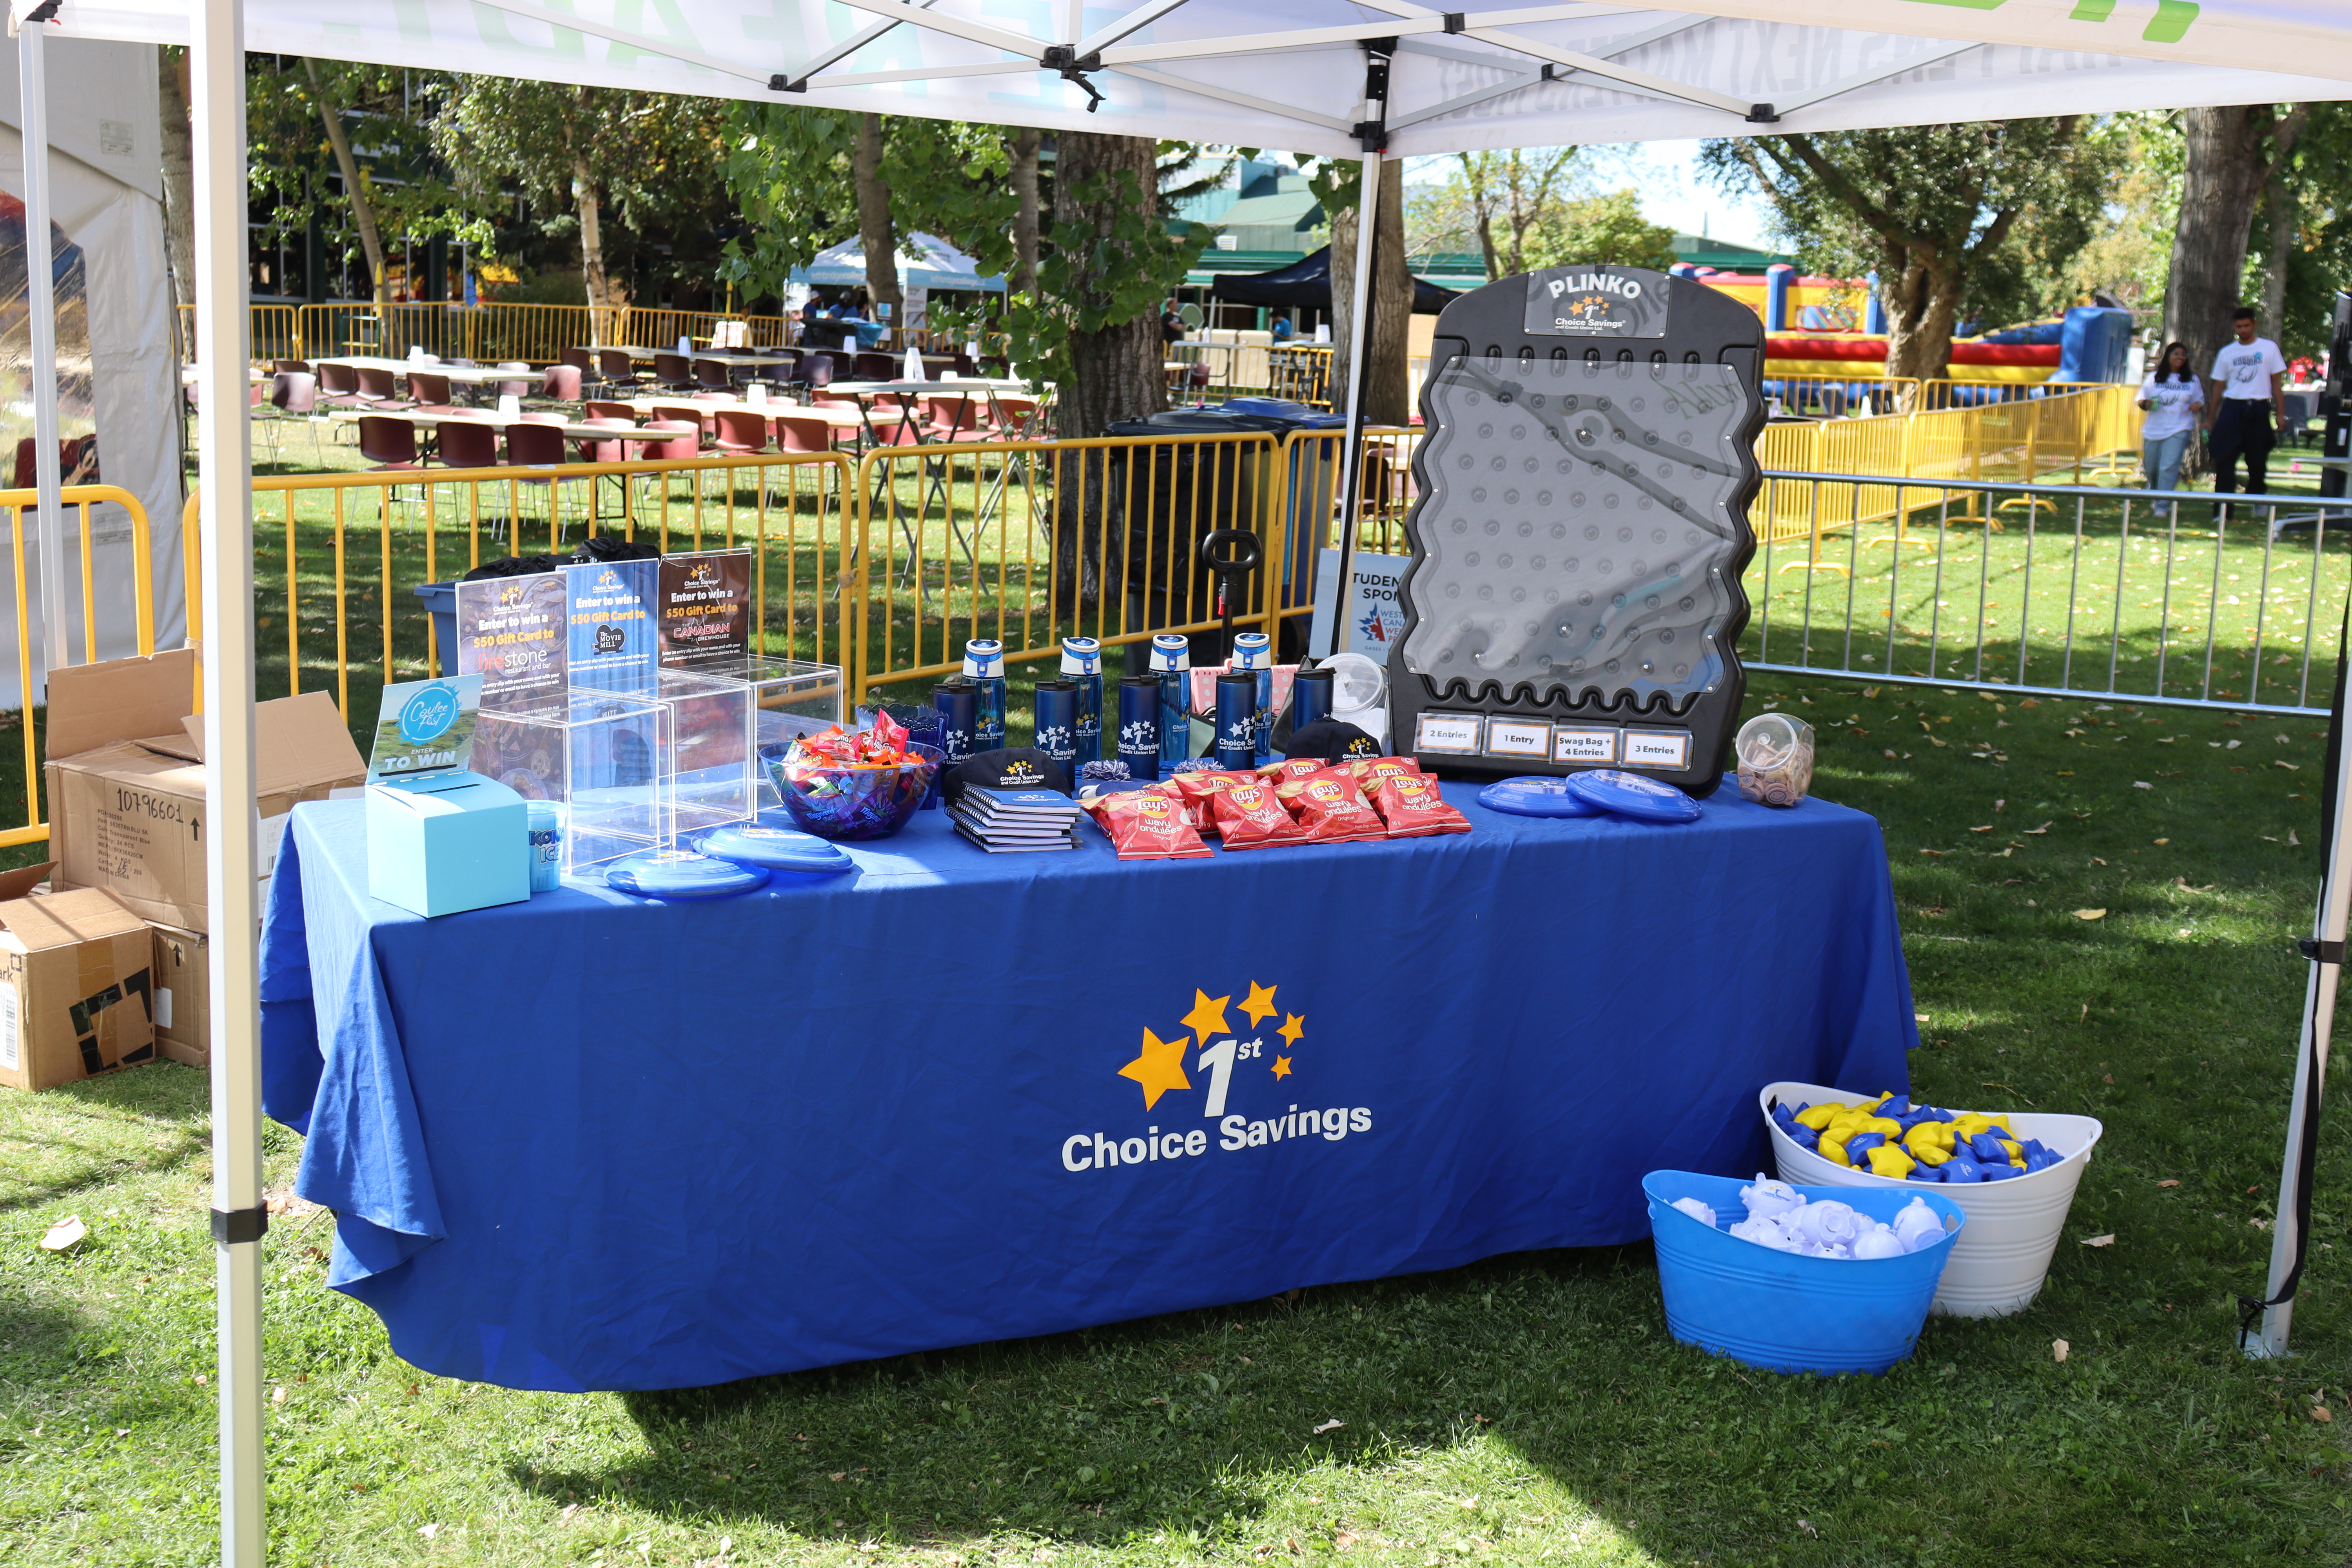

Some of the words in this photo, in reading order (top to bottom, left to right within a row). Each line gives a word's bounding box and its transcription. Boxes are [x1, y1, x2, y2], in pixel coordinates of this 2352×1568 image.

[1548, 273, 1641, 299] PLINKO
[1584, 305, 1599, 319] 1st
[576, 598, 602, 608] Enter
[603, 597, 613, 606] to
[615, 593, 633, 605] win
[671, 593, 696, 603] Enter
[697, 591, 706, 600] to
[708, 588, 726, 599] win
[571, 613, 590, 625] $50
[592, 612, 610, 622] Gift
[611, 609, 634, 621] Card
[635, 610, 646, 619] to
[666, 607, 684, 619] $50
[686, 606, 703, 616] Gift
[705, 603, 726, 614] Card
[727, 604, 738, 612] to
[479, 619, 506, 631] Enter
[508, 617, 519, 627] to
[521, 613, 540, 625] win
[541, 614, 548, 622] a
[673, 622, 730, 638] CANADIAN
[474, 636, 494, 649] $50
[496, 633, 516, 645] Gift
[517, 629, 542, 642] Card
[543, 629, 554, 639] to
[477, 650, 547, 671] firestone
[410, 701, 448, 721] Coulee
[1134, 730, 1147, 744] 1st
[1244, 726, 1254, 740] 1st
[1510, 735, 1534, 744] Entry
[1049, 735, 1062, 749] 1st
[1559, 737, 1583, 746] Swag
[1643, 746, 1674, 754] Entries
[385, 756, 411, 770] TO
[417, 750, 456, 767] WIN
[1311, 783, 1339, 799] Lay's
[1394, 779, 1423, 788] Lay's
[1230, 787, 1261, 804] Lay's
[1404, 794, 1431, 804] wavy
[117, 787, 184, 823] 10796601
[1138, 799, 1168, 812] Lay's
[1245, 808, 1270, 816] wavy
[1145, 818, 1171, 829] wavy
[110, 829, 137, 841] Transparent
[529, 826, 564, 846] KONA
[539, 844, 561, 864] ICE
[1198, 1037, 1263, 1117] 1st
[1062, 1125, 1207, 1172] Choice
[1219, 1104, 1373, 1151] Savings
